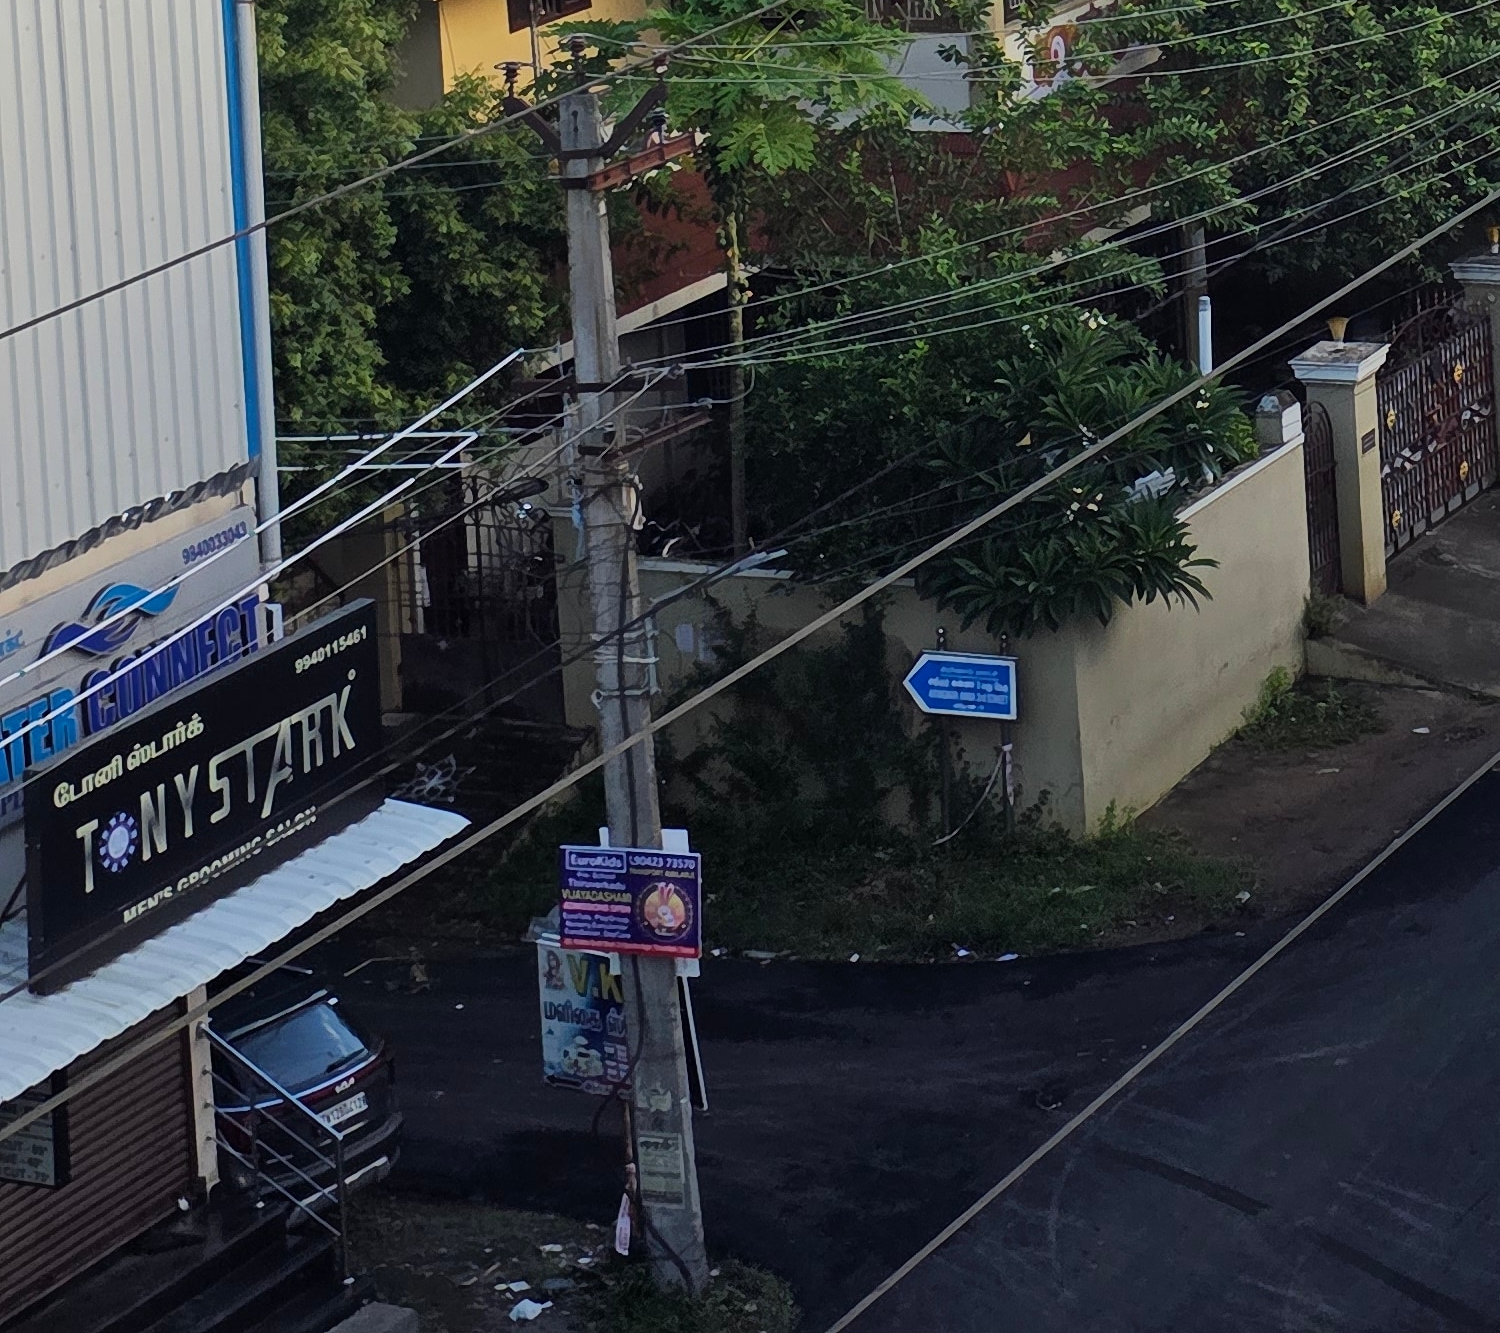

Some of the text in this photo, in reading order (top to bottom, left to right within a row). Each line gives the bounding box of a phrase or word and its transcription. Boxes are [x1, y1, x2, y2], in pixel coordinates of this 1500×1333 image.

[85, 594, 260, 734] CONNECT
[54, 753, 123, 809] டோனி
[127, 712, 205, 771] ஸ்டார்க்
